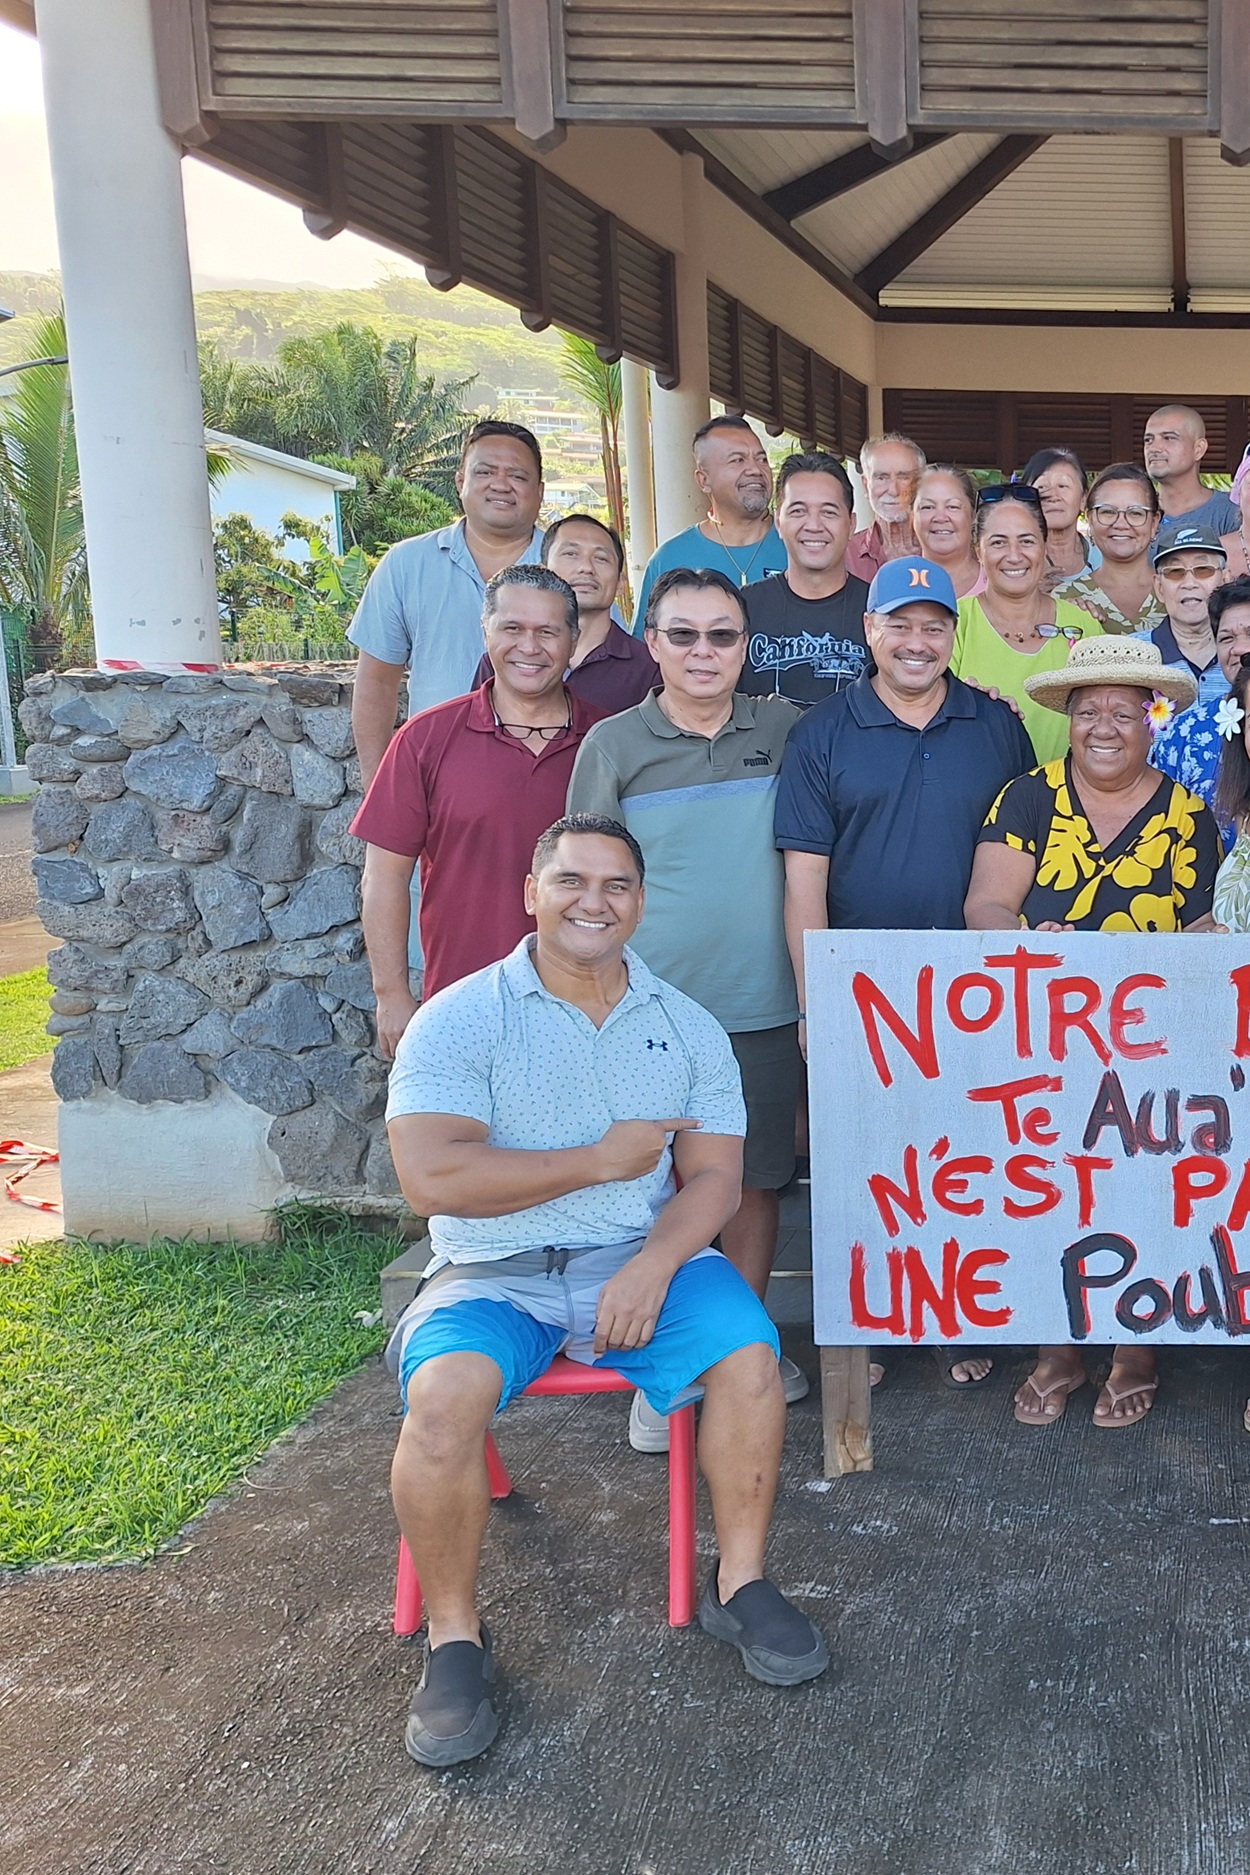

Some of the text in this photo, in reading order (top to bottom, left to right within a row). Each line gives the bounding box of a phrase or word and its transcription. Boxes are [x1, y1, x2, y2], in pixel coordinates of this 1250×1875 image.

[852, 944, 1168, 1088] NOTRE
[967, 1074, 1063, 1146] Te
[849, 1237, 1012, 1343] UNE
